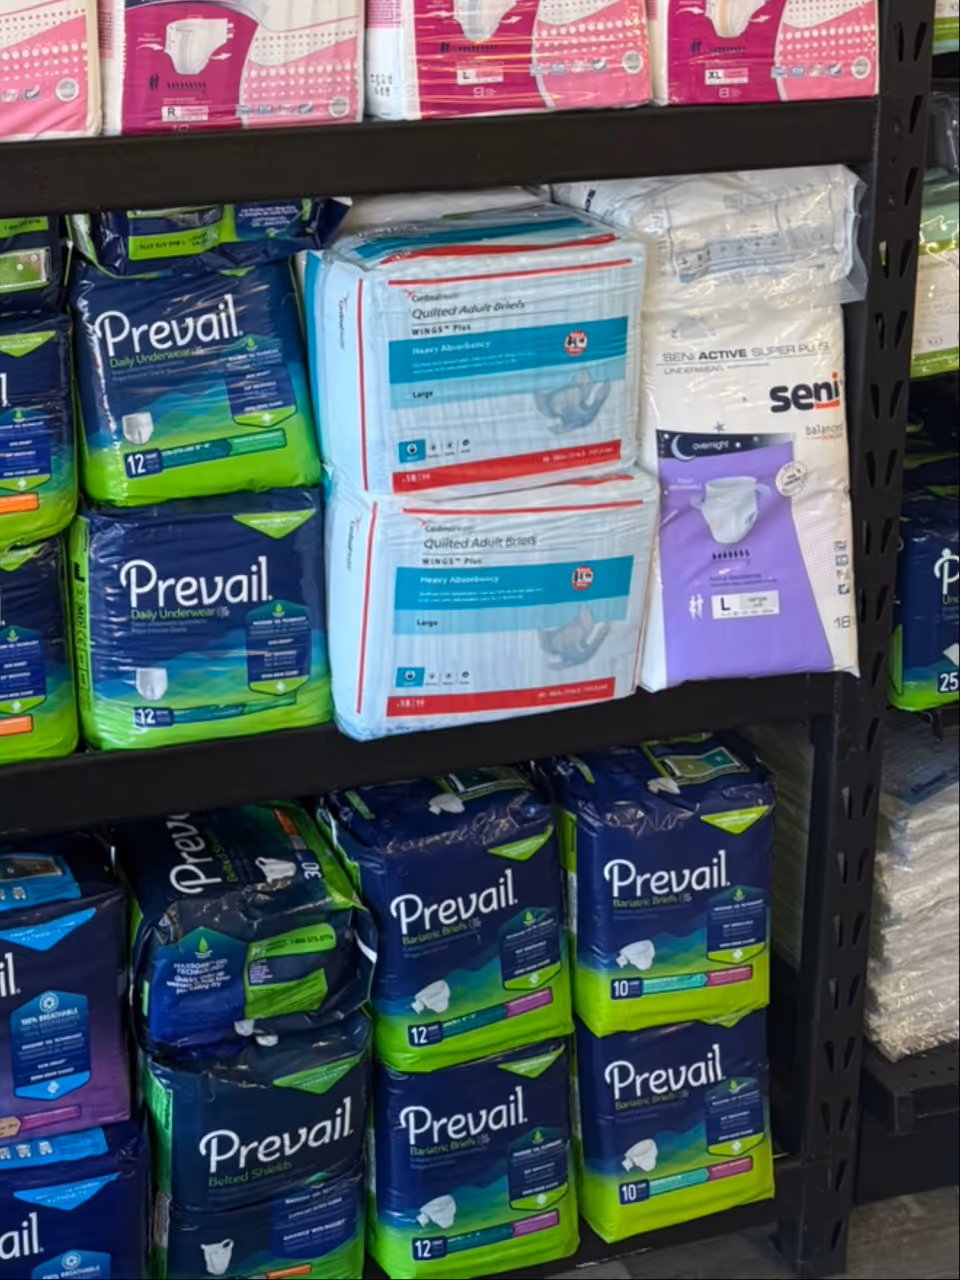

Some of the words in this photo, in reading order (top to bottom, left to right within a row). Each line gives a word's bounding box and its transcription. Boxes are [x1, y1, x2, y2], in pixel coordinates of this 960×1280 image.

[462, 70, 471, 81] L
[707, 70, 723, 81] XL
[167, 107, 176, 117] R
[411, 306, 457, 320] Quilted
[458, 302, 491, 315] Adult
[94, 293, 240, 357] Prevail
[411, 326, 443, 336] WINGS
[411, 346, 439, 357] Heavy
[697, 348, 748, 361] ACTIVE
[750, 344, 796, 358] SUPER
[110, 356, 135, 369] Daily
[412, 390, 434, 400] Large
[769, 372, 841, 413] seni
[691, 439, 730, 452] overnight
[126, 454, 147, 477] 12
[423, 537, 470, 550] Quilted
[471, 536, 503, 548] Adult
[119, 555, 269, 609] Prevail
[720, 597, 731, 611] L
[130, 608, 158, 621] Daily
[159, 606, 216, 620] Underwear
[416, 618, 439, 628] Large
[940, 672, 959, 692] 25
[301, 861, 321, 880] 30
[603, 849, 727, 898] Prevail
[390, 868, 515, 935] Prevail
[612, 896, 651, 909] Bariatric
[652, 893, 678, 906] Briefs
[612, 979, 629, 997] 10
[410, 1025, 428, 1045] 12
[604, 1043, 723, 1100] Prevail
[399, 1085, 526, 1146] Prevail
[199, 1096, 351, 1173] Prevail
[208, 1170, 249, 1188] Belted
[621, 1183, 637, 1201] 10
[414, 1239, 432, 1258] 12
